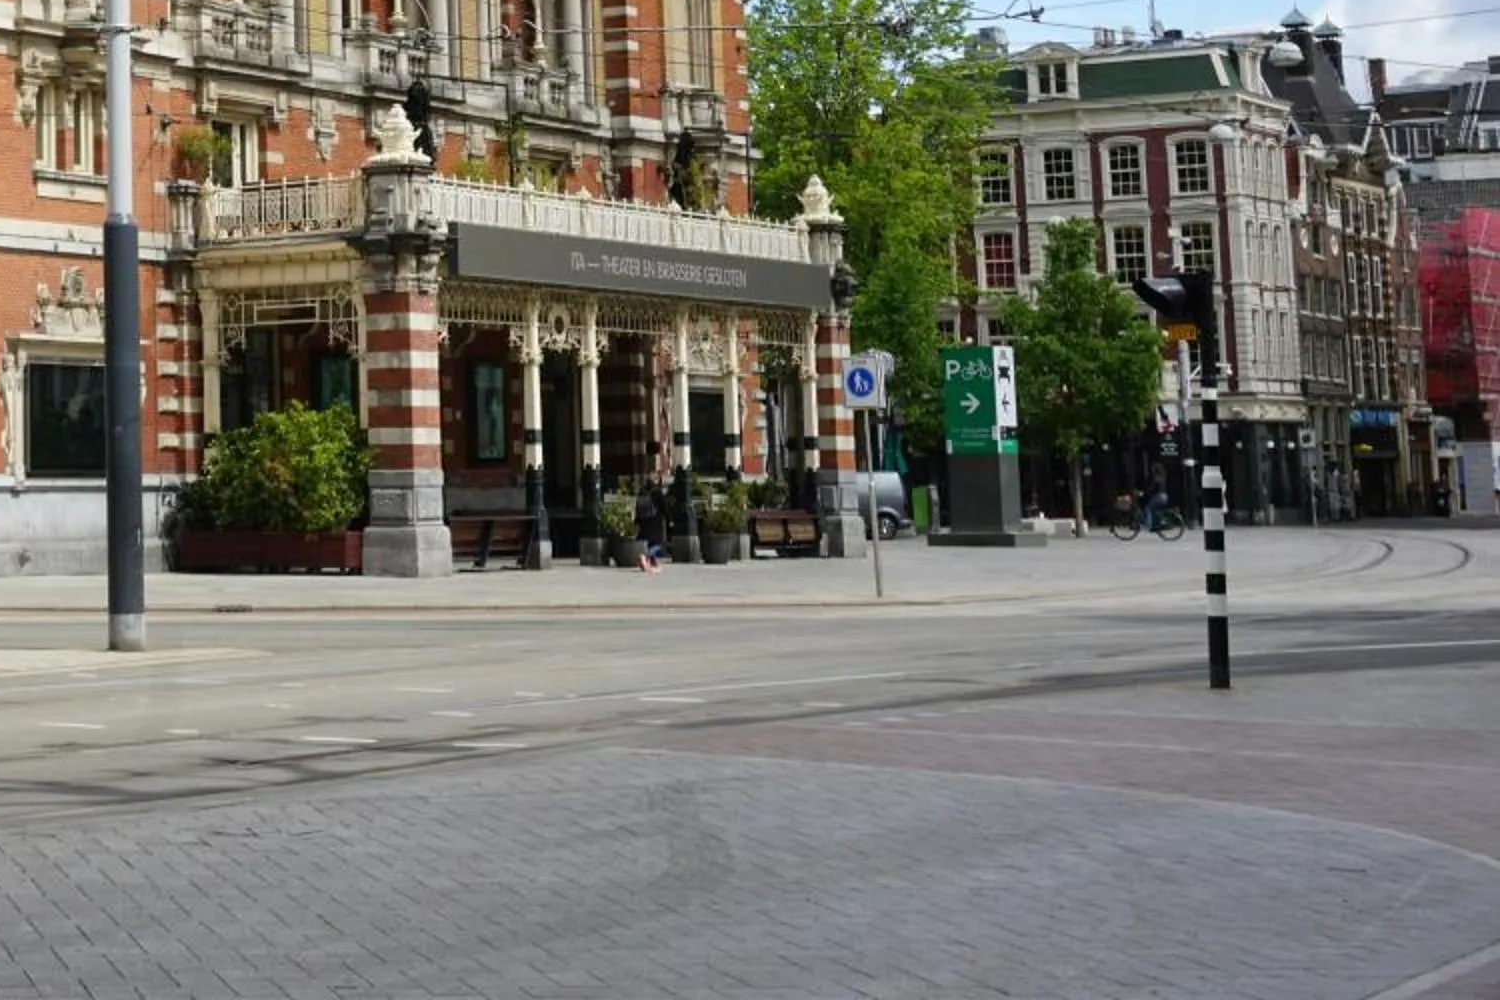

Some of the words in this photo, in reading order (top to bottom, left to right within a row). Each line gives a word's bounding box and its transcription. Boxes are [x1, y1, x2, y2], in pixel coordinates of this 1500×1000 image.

[571, 251, 586, 272] ITA
[601, 254, 641, 277] THEATER
[643, 258, 656, 279] EN
[656, 261, 703, 283] BRASSERIE
[703, 266, 747, 288] GESLOTEN
[945, 359, 961, 381] P
